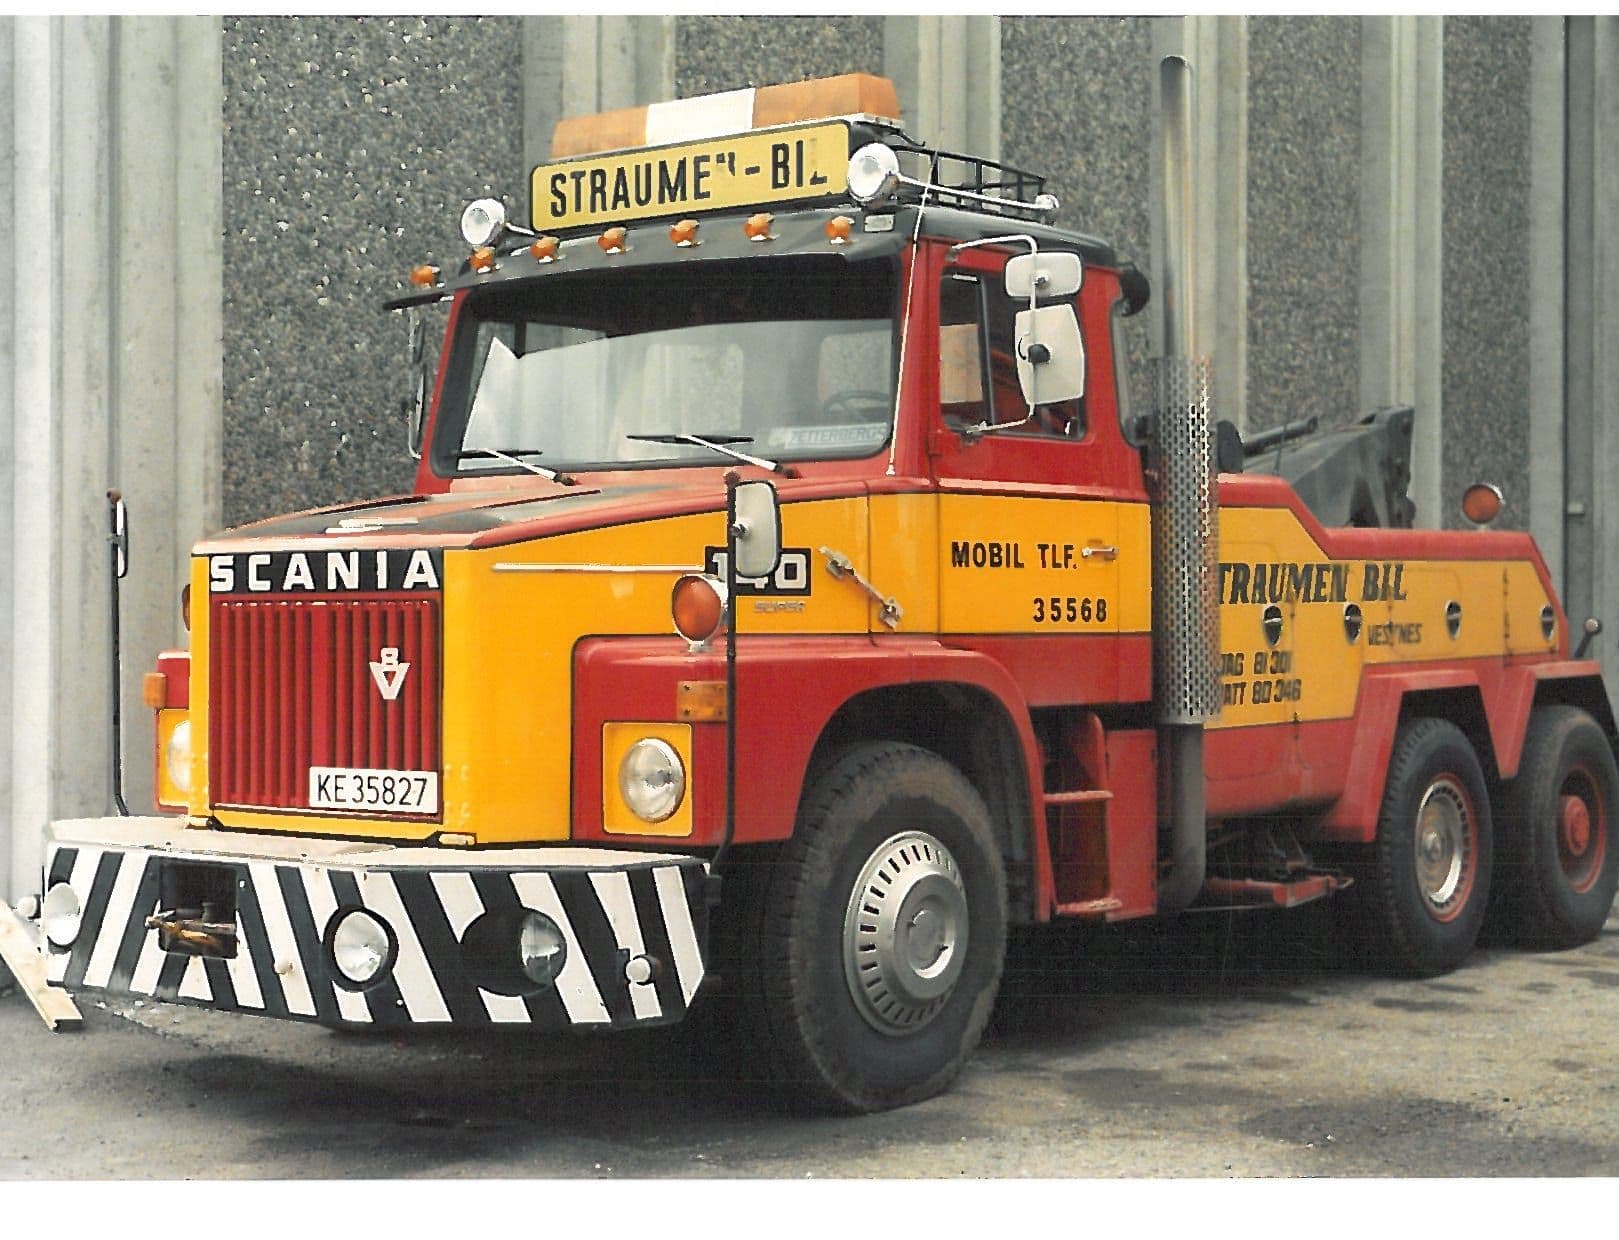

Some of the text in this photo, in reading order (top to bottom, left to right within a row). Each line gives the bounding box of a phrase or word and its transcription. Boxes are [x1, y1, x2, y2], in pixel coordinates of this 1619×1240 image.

[210, 550, 439, 592] SCANIA
[711, 552, 807, 590] 10
[951, 541, 1078, 570] MOBIL TLF.
[1218, 562, 1407, 605] TRAUMEN BIL
[1033, 597, 1107, 623] 35568
[1222, 681, 1247, 706] ATT
